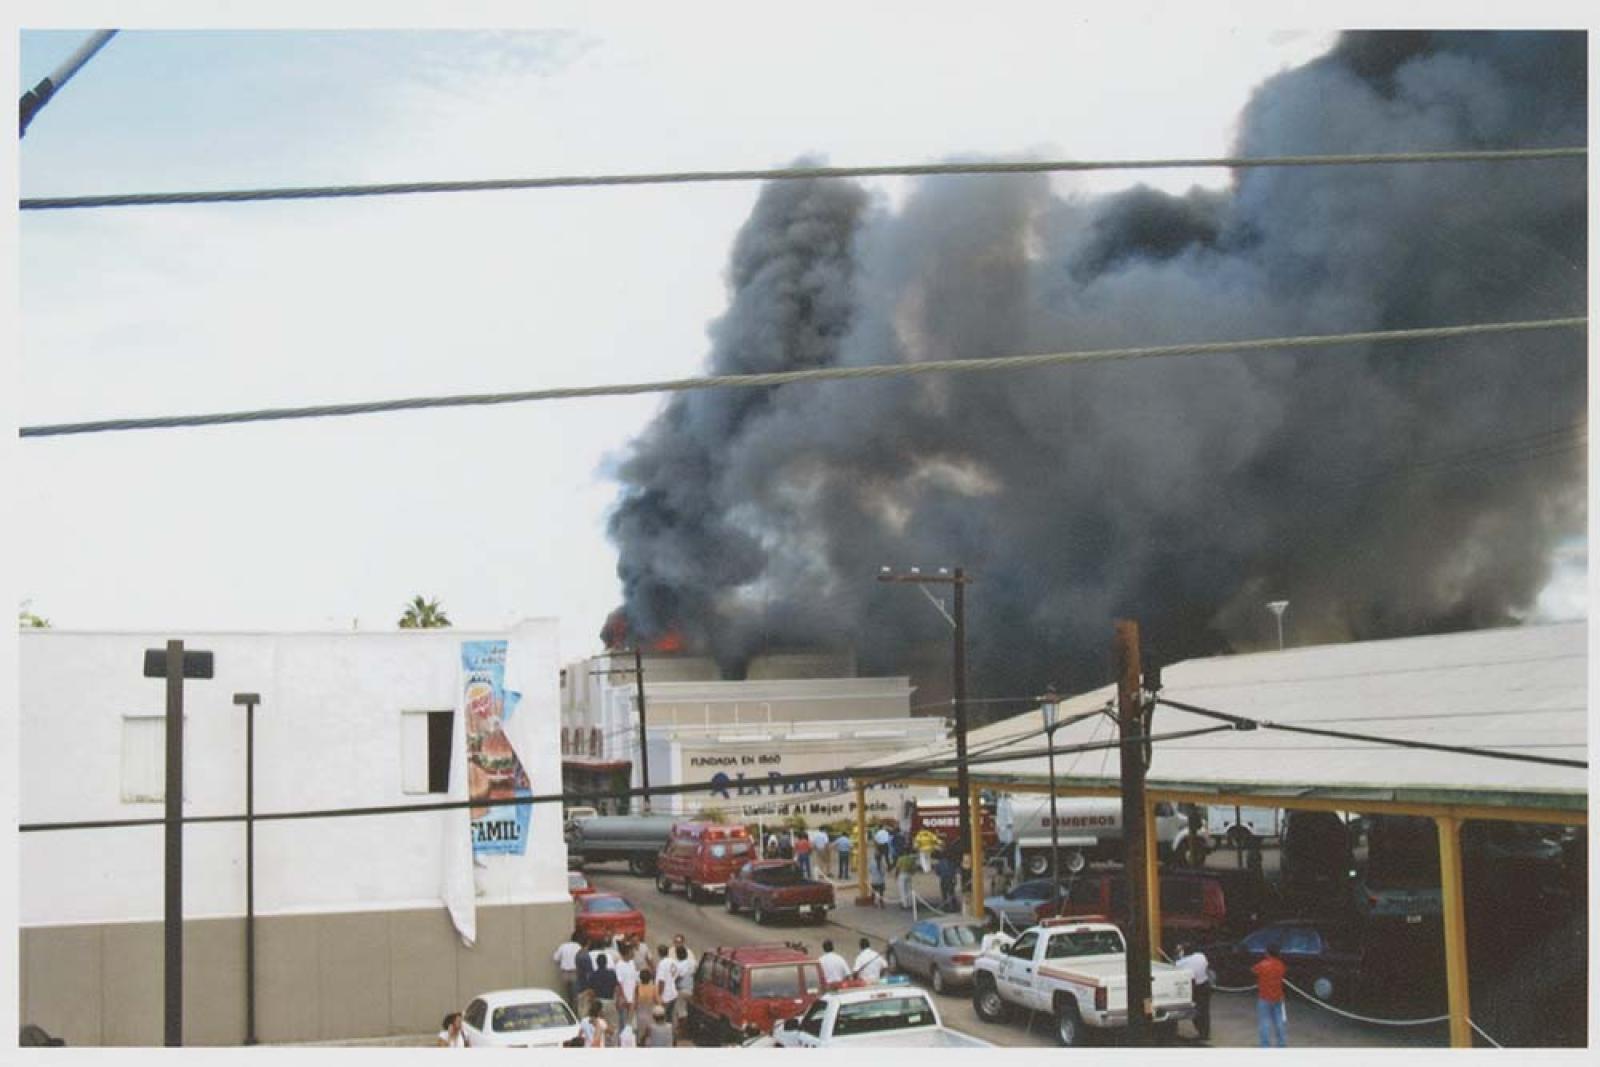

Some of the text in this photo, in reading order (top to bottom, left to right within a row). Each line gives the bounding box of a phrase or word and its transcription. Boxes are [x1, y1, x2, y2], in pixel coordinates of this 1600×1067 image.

[690, 756, 738, 767] FUNDADA
[742, 755, 755, 766] EN
[810, 802, 844, 816] Mejor
